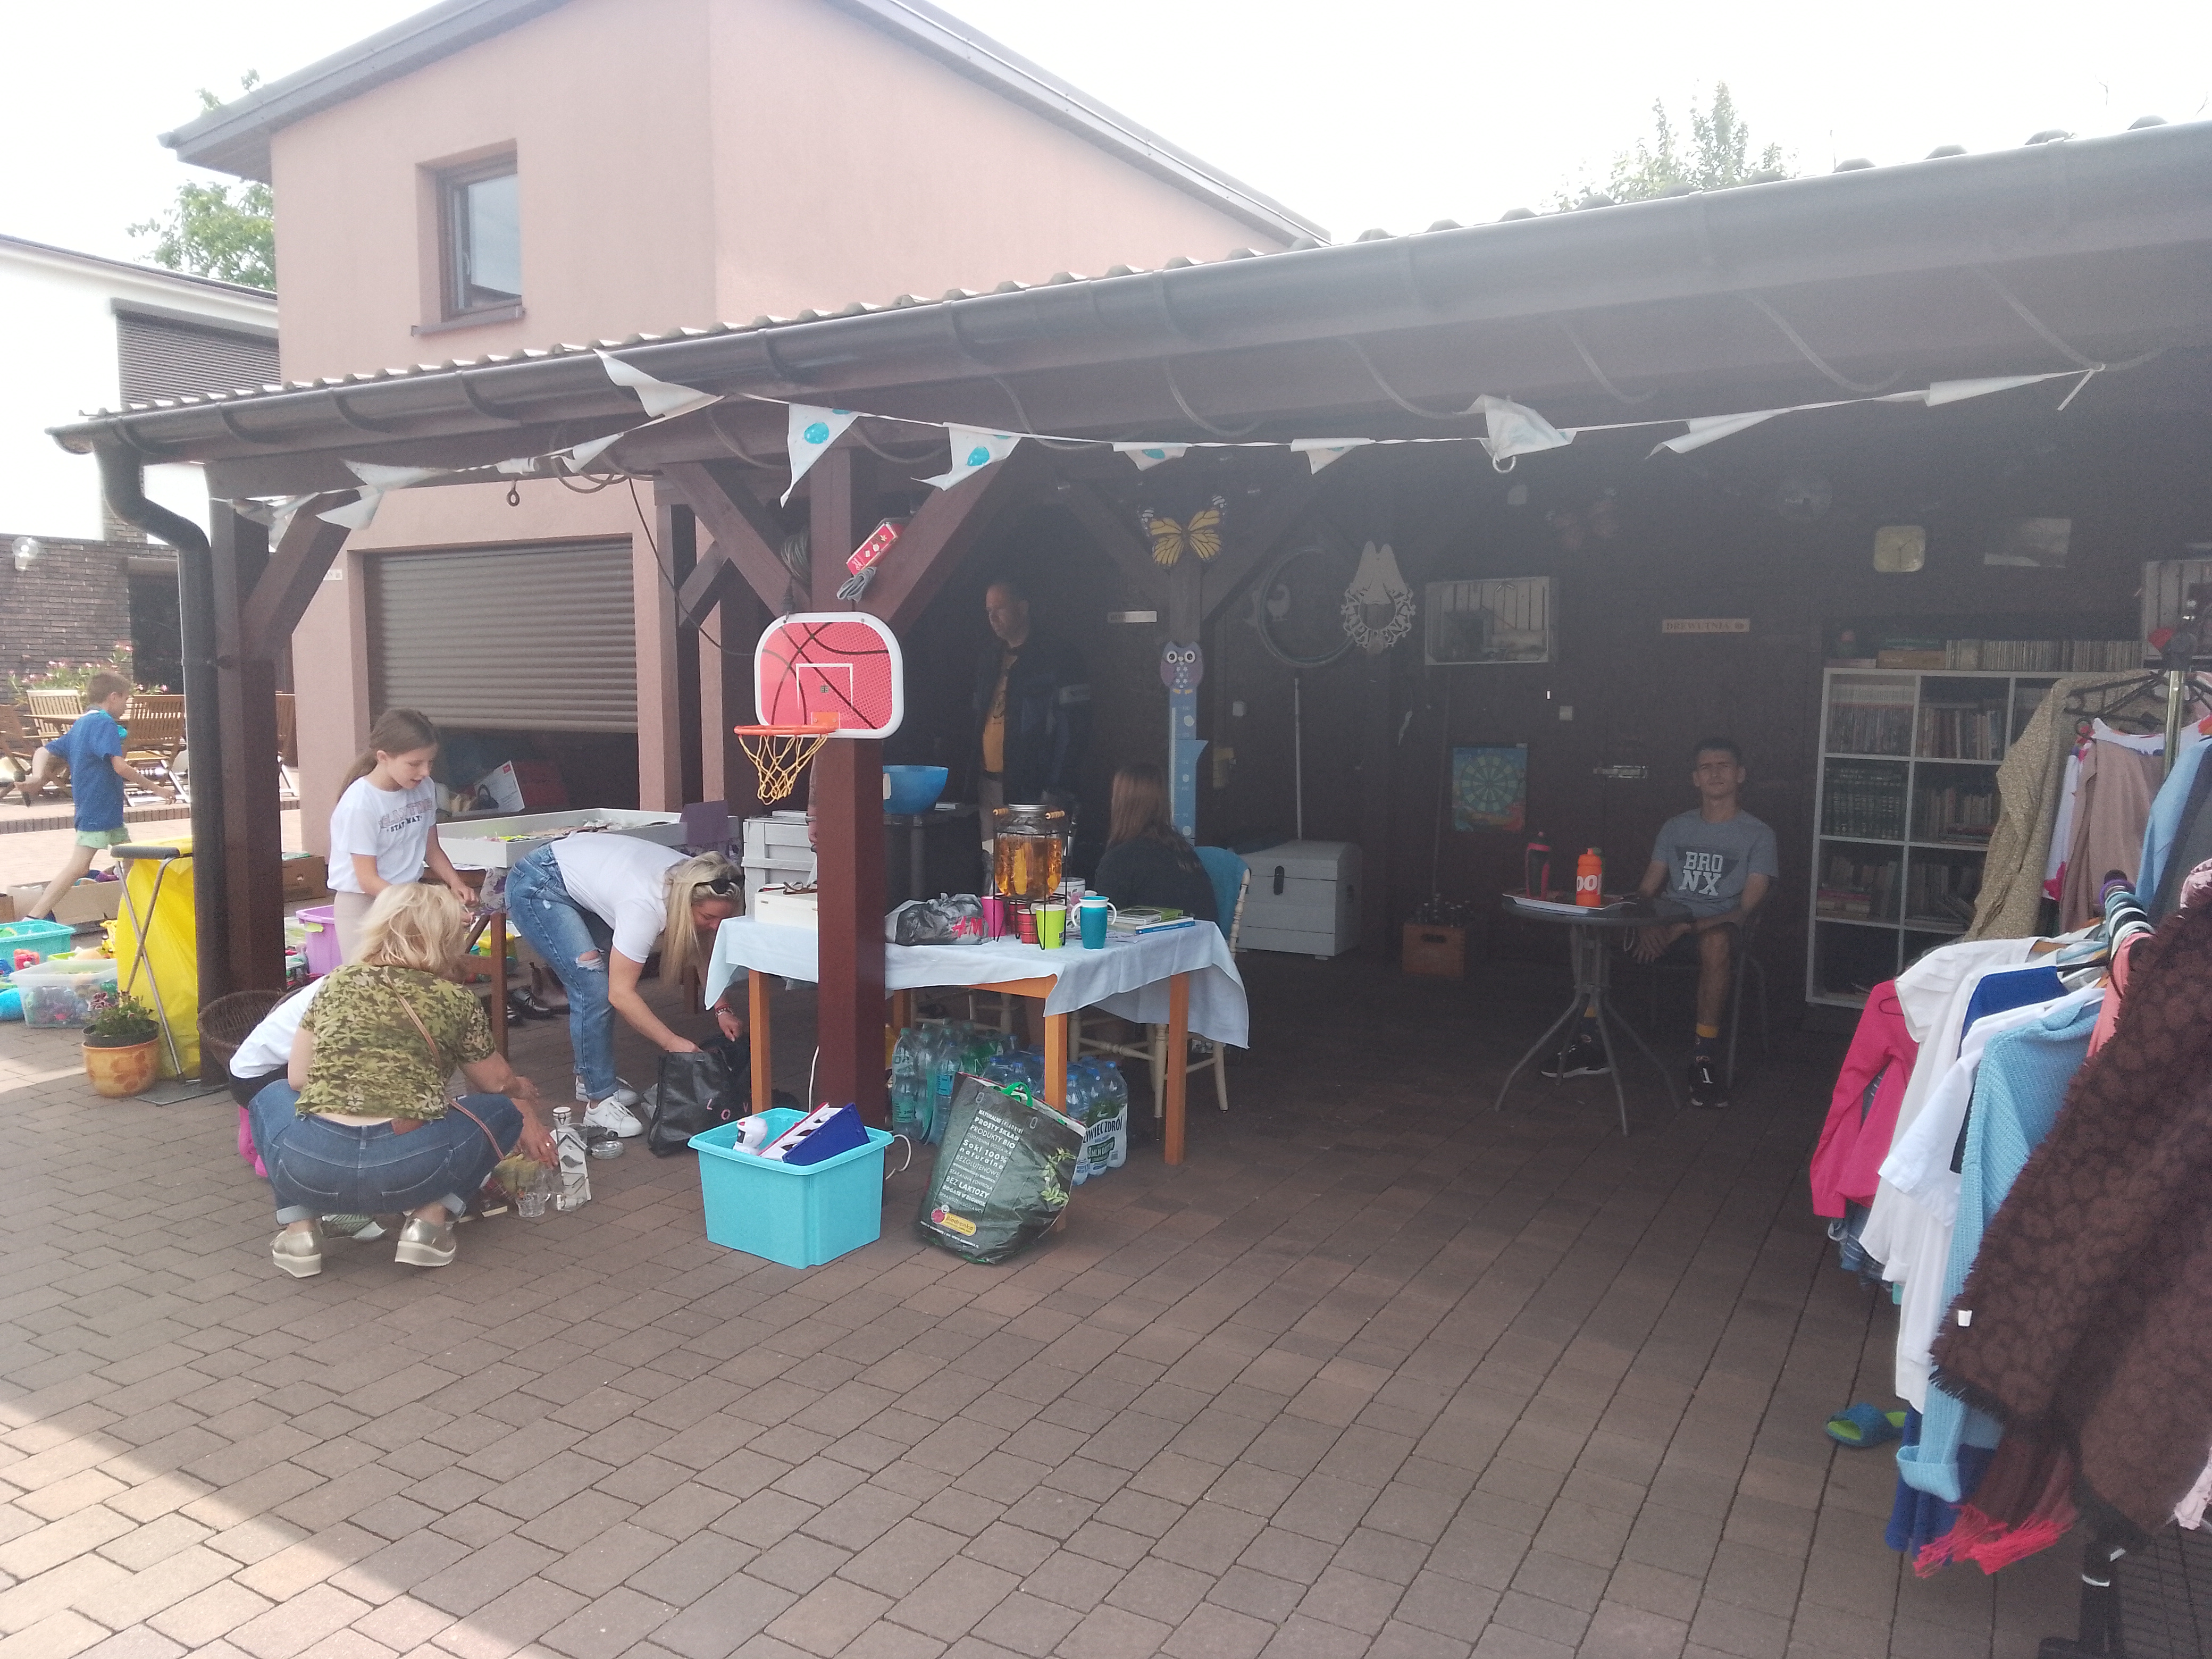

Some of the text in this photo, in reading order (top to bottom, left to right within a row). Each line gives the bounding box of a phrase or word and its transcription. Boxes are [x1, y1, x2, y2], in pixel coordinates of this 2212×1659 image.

[1665, 621, 1730, 631] DREWUTNIA
[390, 821, 405, 832] STAY
[1683, 851, 1723, 873] BRO
[1678, 869, 1721, 896] NX
[974, 1117, 1020, 1142] PROSTY SKŁAD
[978, 1109, 1024, 1135] NATURALNE SKŁADNIKI
[1104, 1116, 1124, 1133] ZDRÓJ
[967, 1133, 1012, 1156] CODZIENNA DOSTAWA
[970, 1124, 1016, 1150] PRODUKTY BIO
[959, 1146, 1004, 1170] naturalne
[962, 1139, 1007, 1163] Soki 100%
[956, 1154, 1001, 1178] BEZGLUTENOWE
[945, 1175, 990, 1199] BEZ LAKTOZY
[949, 1168, 993, 1191] STARANNA KONTROLA
[961, 1203, 984, 1214] DOSTAWCY
[945, 1216, 974, 1231] Biedronka
